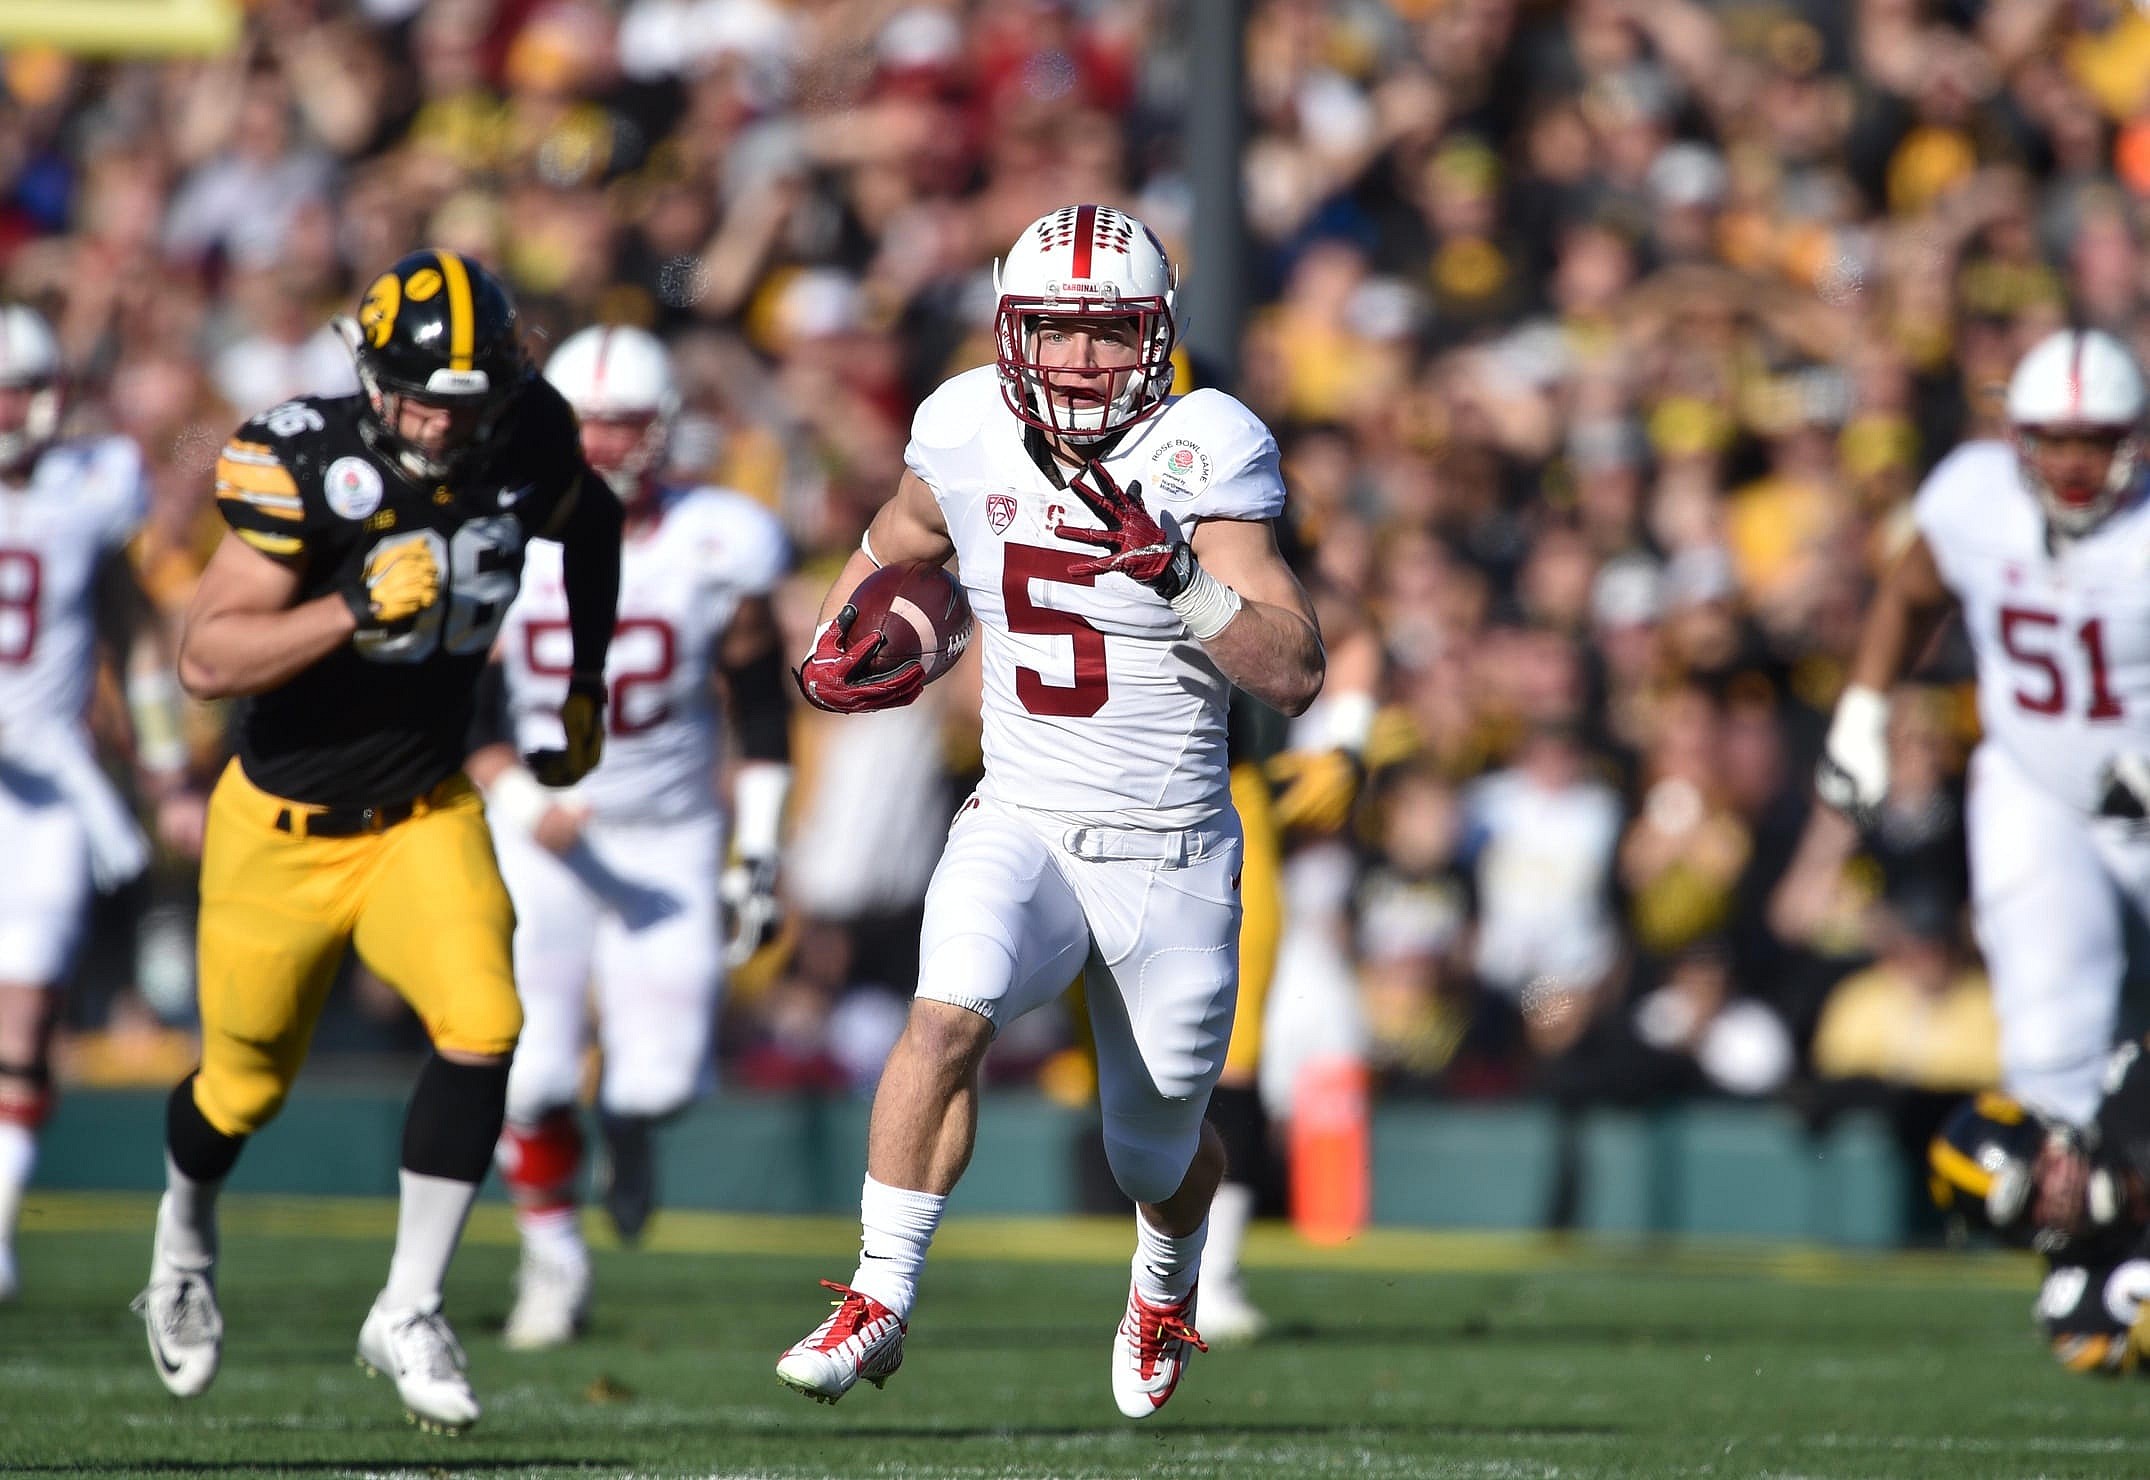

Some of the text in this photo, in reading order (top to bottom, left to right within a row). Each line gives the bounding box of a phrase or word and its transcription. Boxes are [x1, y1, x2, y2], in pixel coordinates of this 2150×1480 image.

[1062, 283, 1099, 293] CARDINAL
[1152, 439, 1210, 483] ROSE BOWL GAME
[988, 497, 1015, 521] PAC
[992, 512, 1006, 527] 12
[1002, 541, 1109, 718] 5
[524, 618, 675, 738] 52
[1999, 606, 2124, 722] 51
